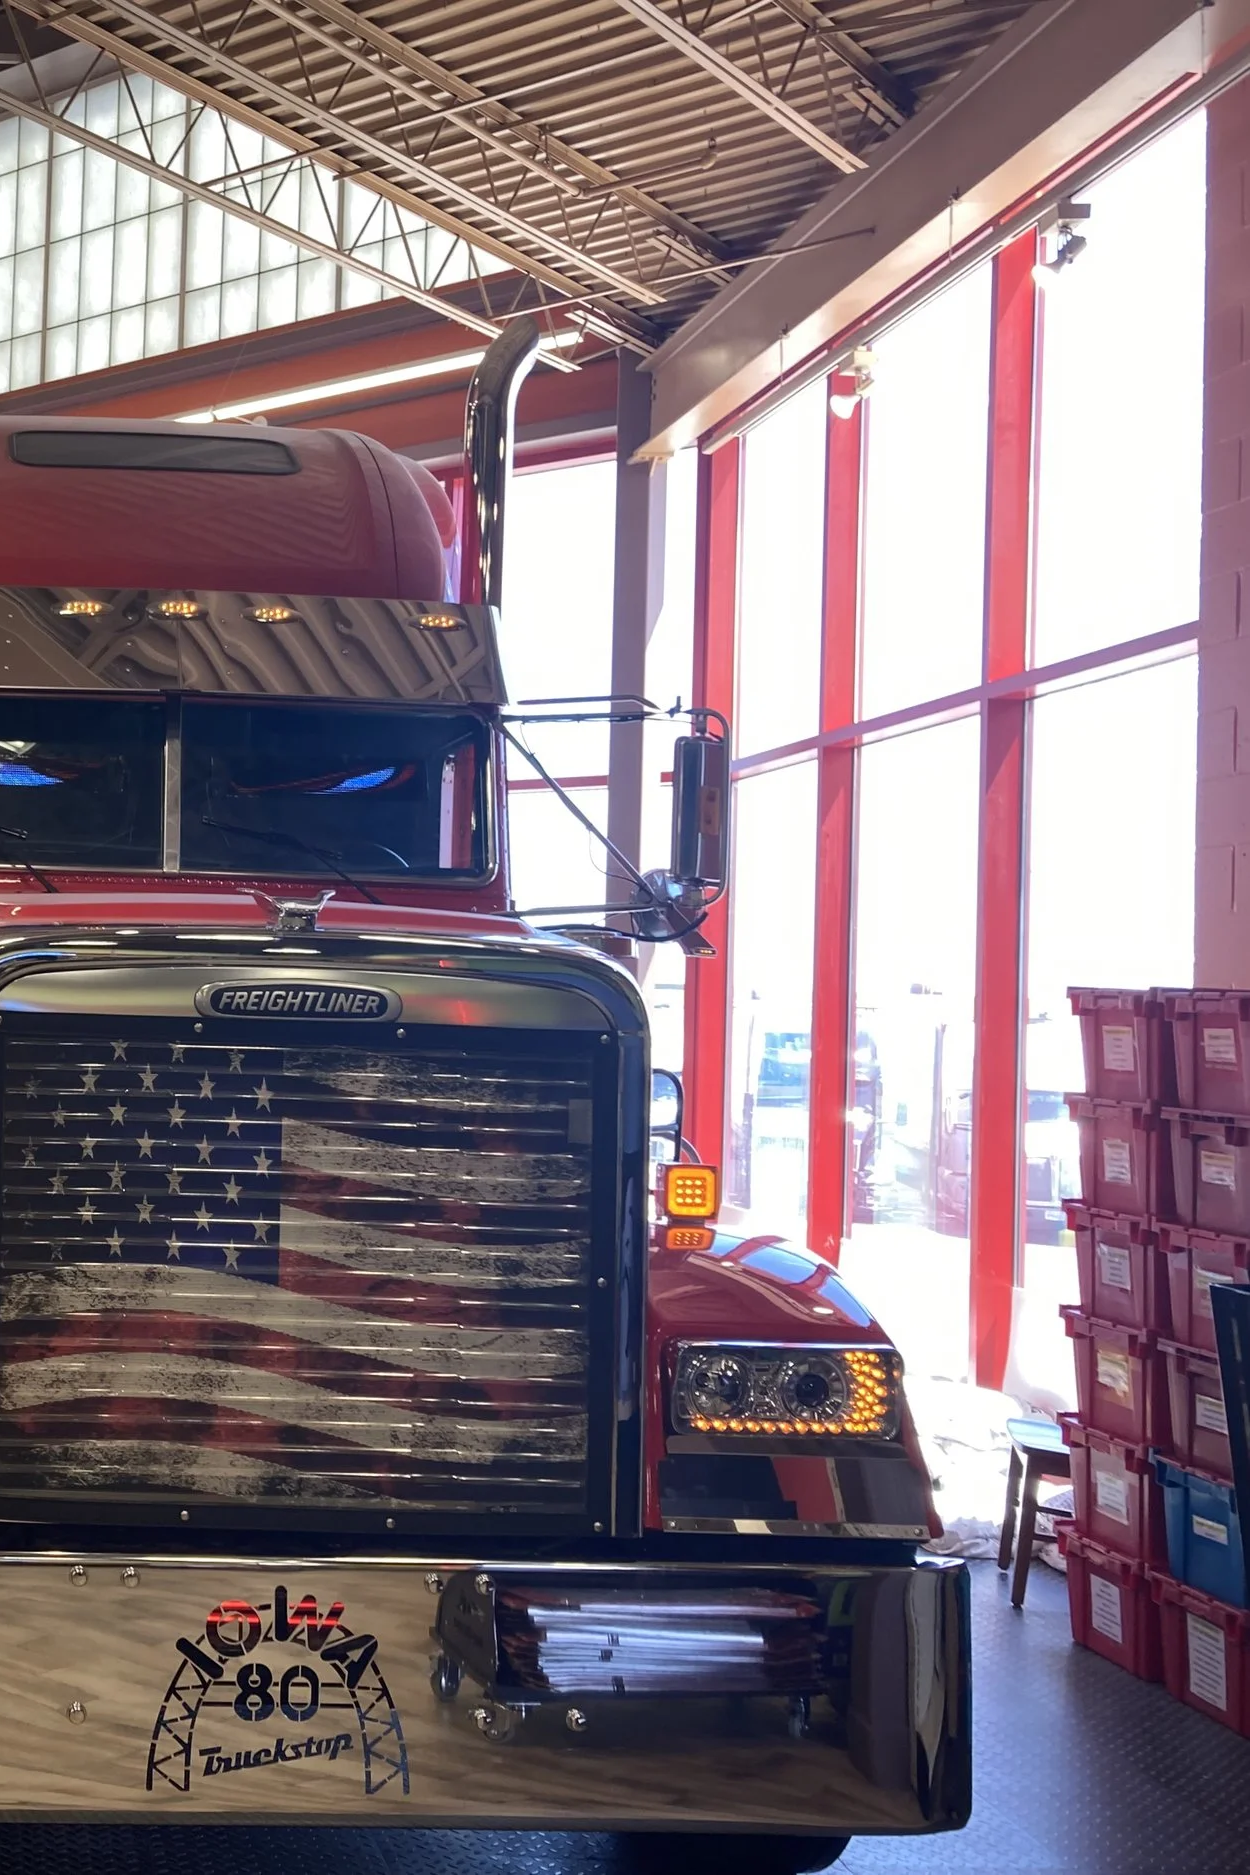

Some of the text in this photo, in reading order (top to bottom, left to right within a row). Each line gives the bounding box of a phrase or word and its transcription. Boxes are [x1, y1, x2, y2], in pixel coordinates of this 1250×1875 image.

[218, 990, 381, 1014] FREIGHTLINER
[175, 1585, 379, 1690] IOWA
[234, 1663, 320, 1722] 80
[199, 1733, 354, 1777] Truckstop
